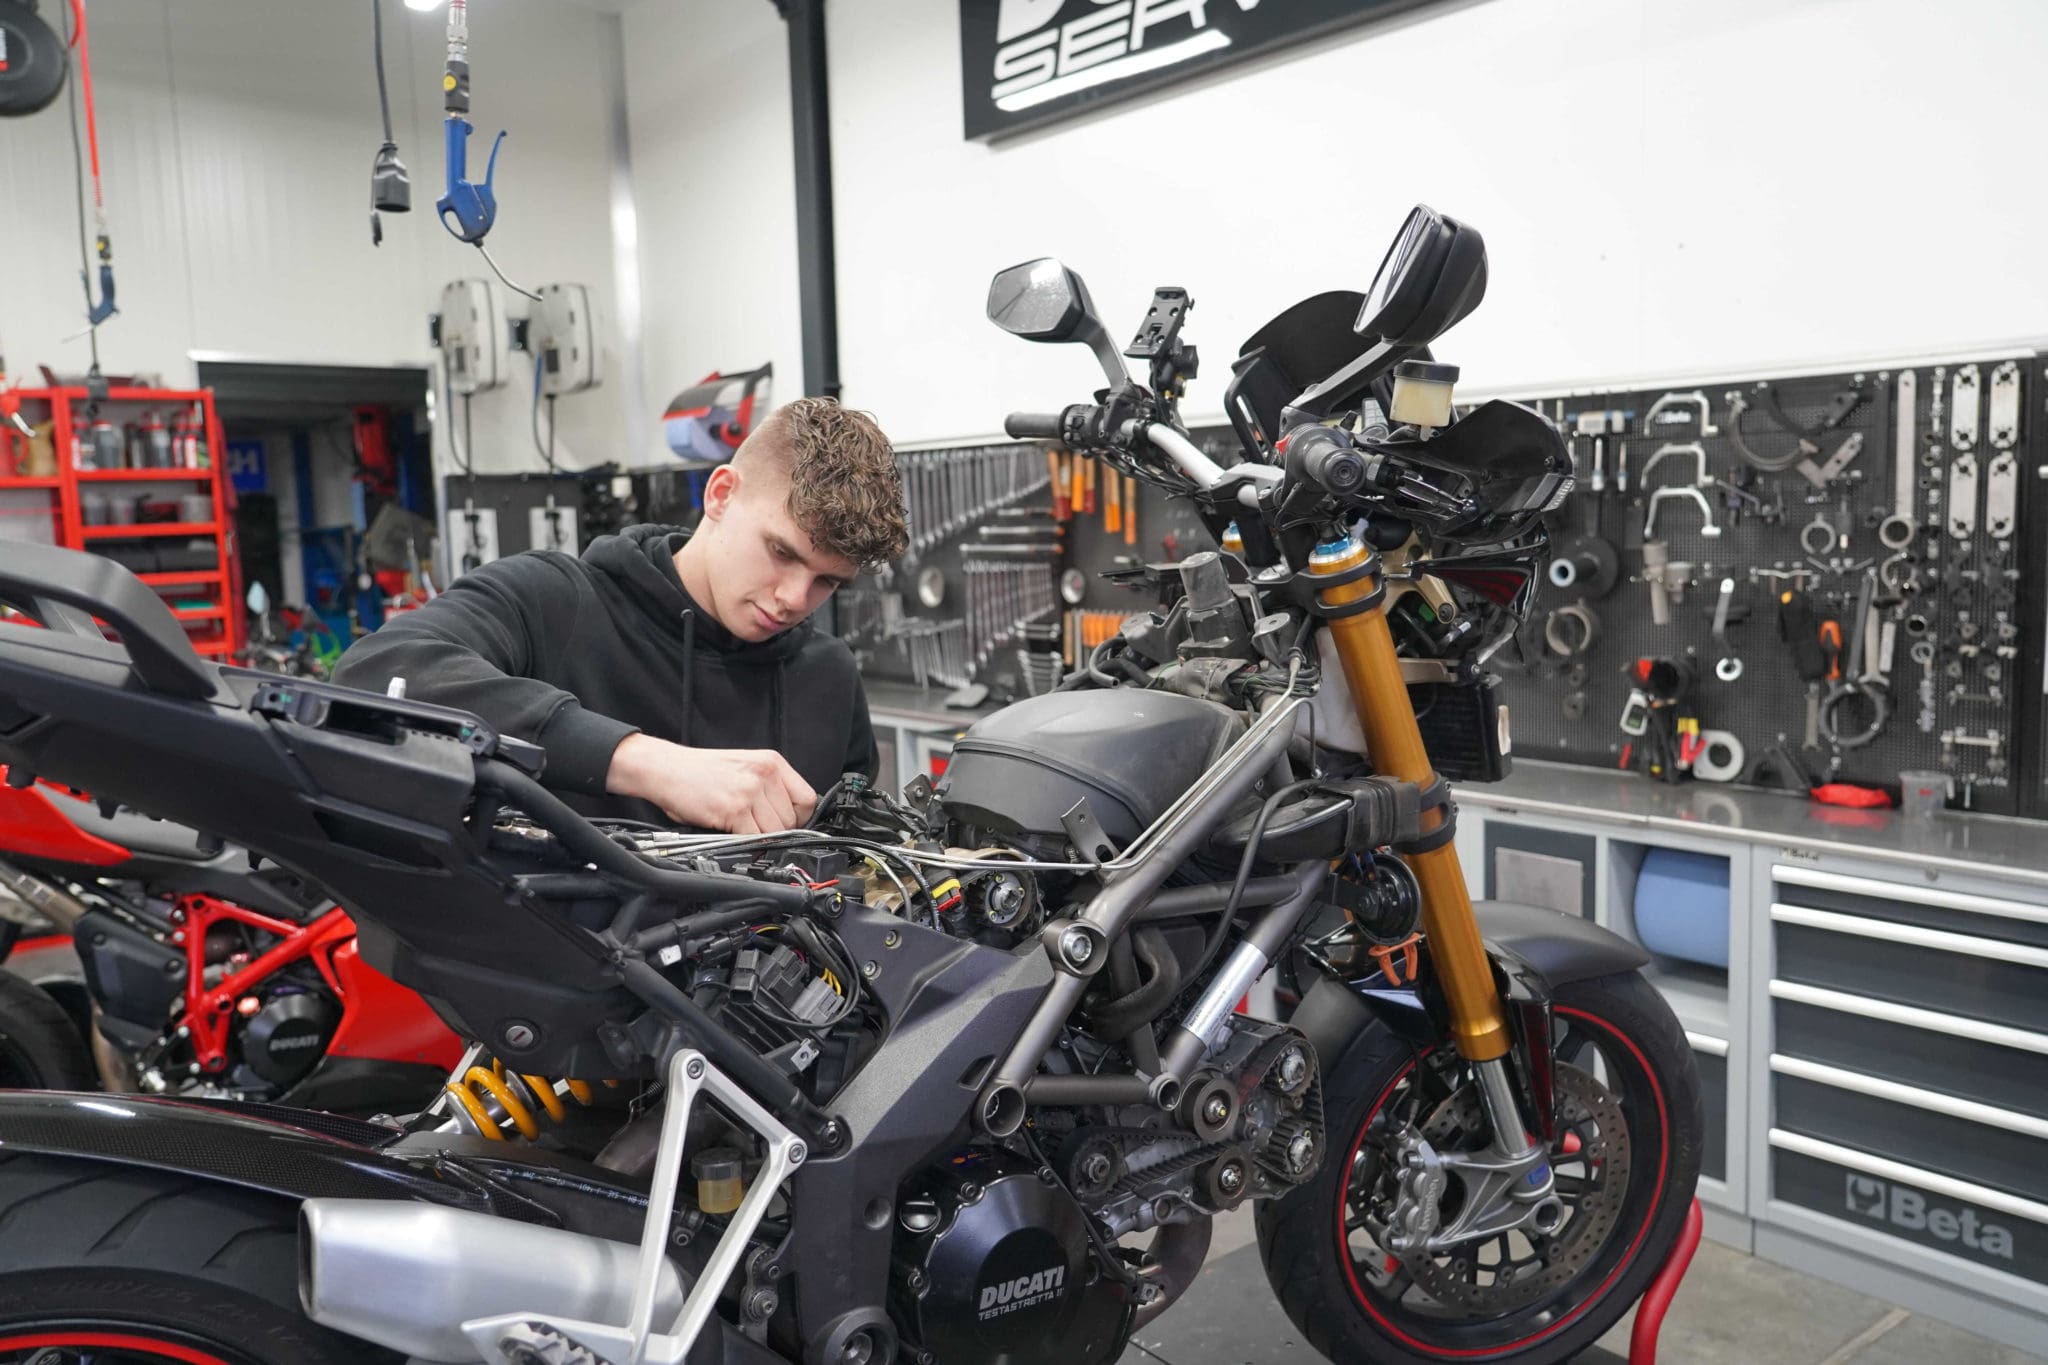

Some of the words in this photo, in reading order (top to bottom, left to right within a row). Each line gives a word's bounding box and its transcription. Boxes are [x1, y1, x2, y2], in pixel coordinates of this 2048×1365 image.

[991, 0, 1262, 101] SER
[1890, 1184, 2014, 1260] Beta
[978, 1291, 1054, 1321] TESTASTRETTA
[979, 1264, 1065, 1311] DUCATI
